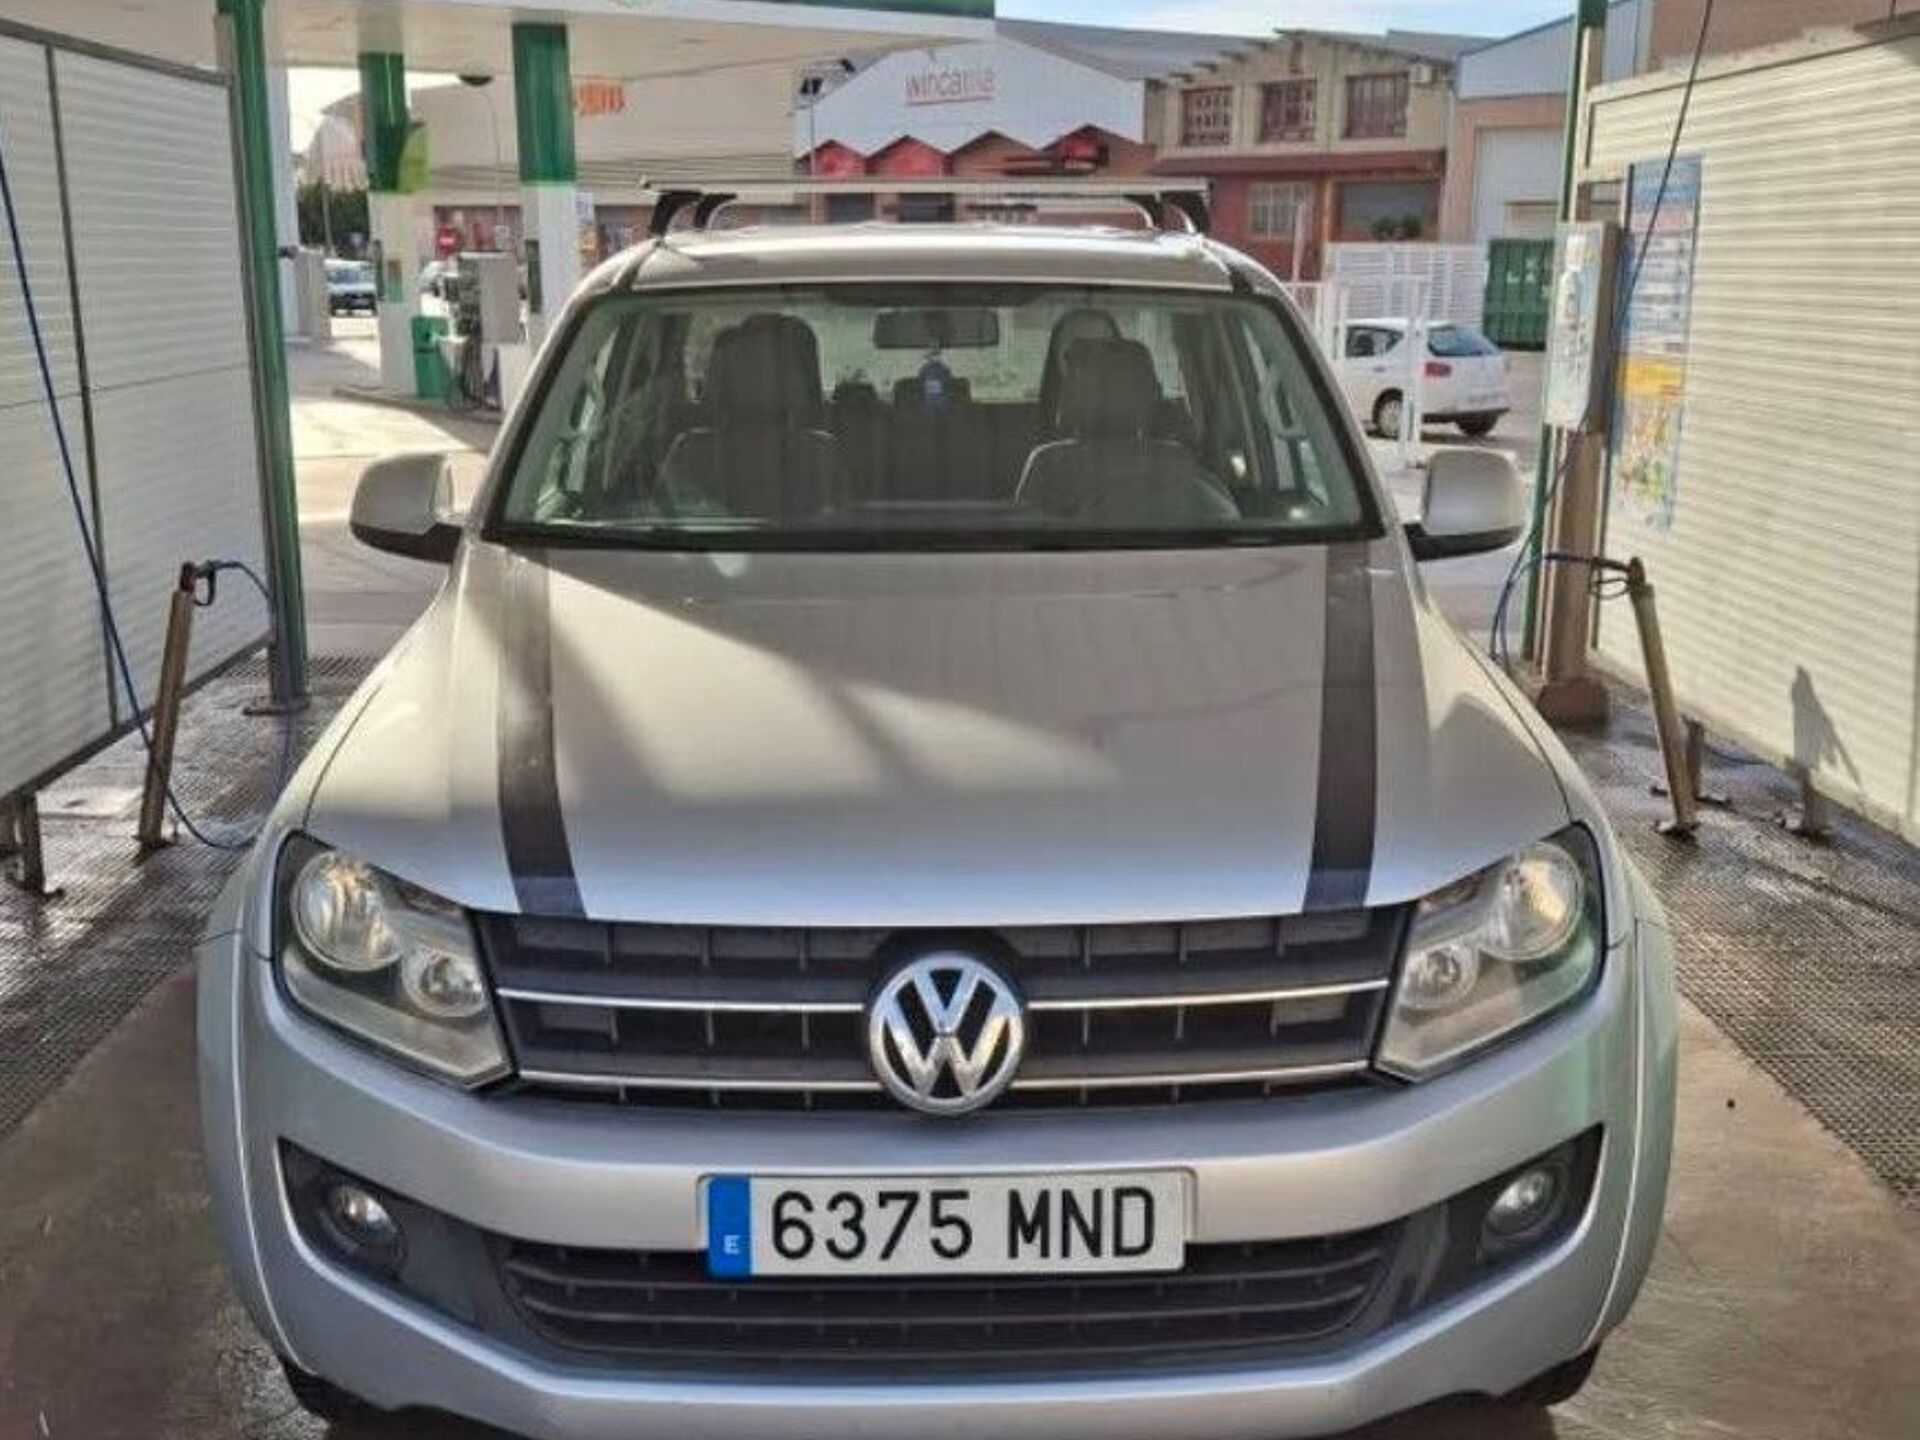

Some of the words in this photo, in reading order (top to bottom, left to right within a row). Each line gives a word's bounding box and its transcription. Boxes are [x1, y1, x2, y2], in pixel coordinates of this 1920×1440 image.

[724, 1235, 739, 1254] E
[771, 1190, 973, 1260] 6375
[1008, 1187, 1154, 1258] MND
